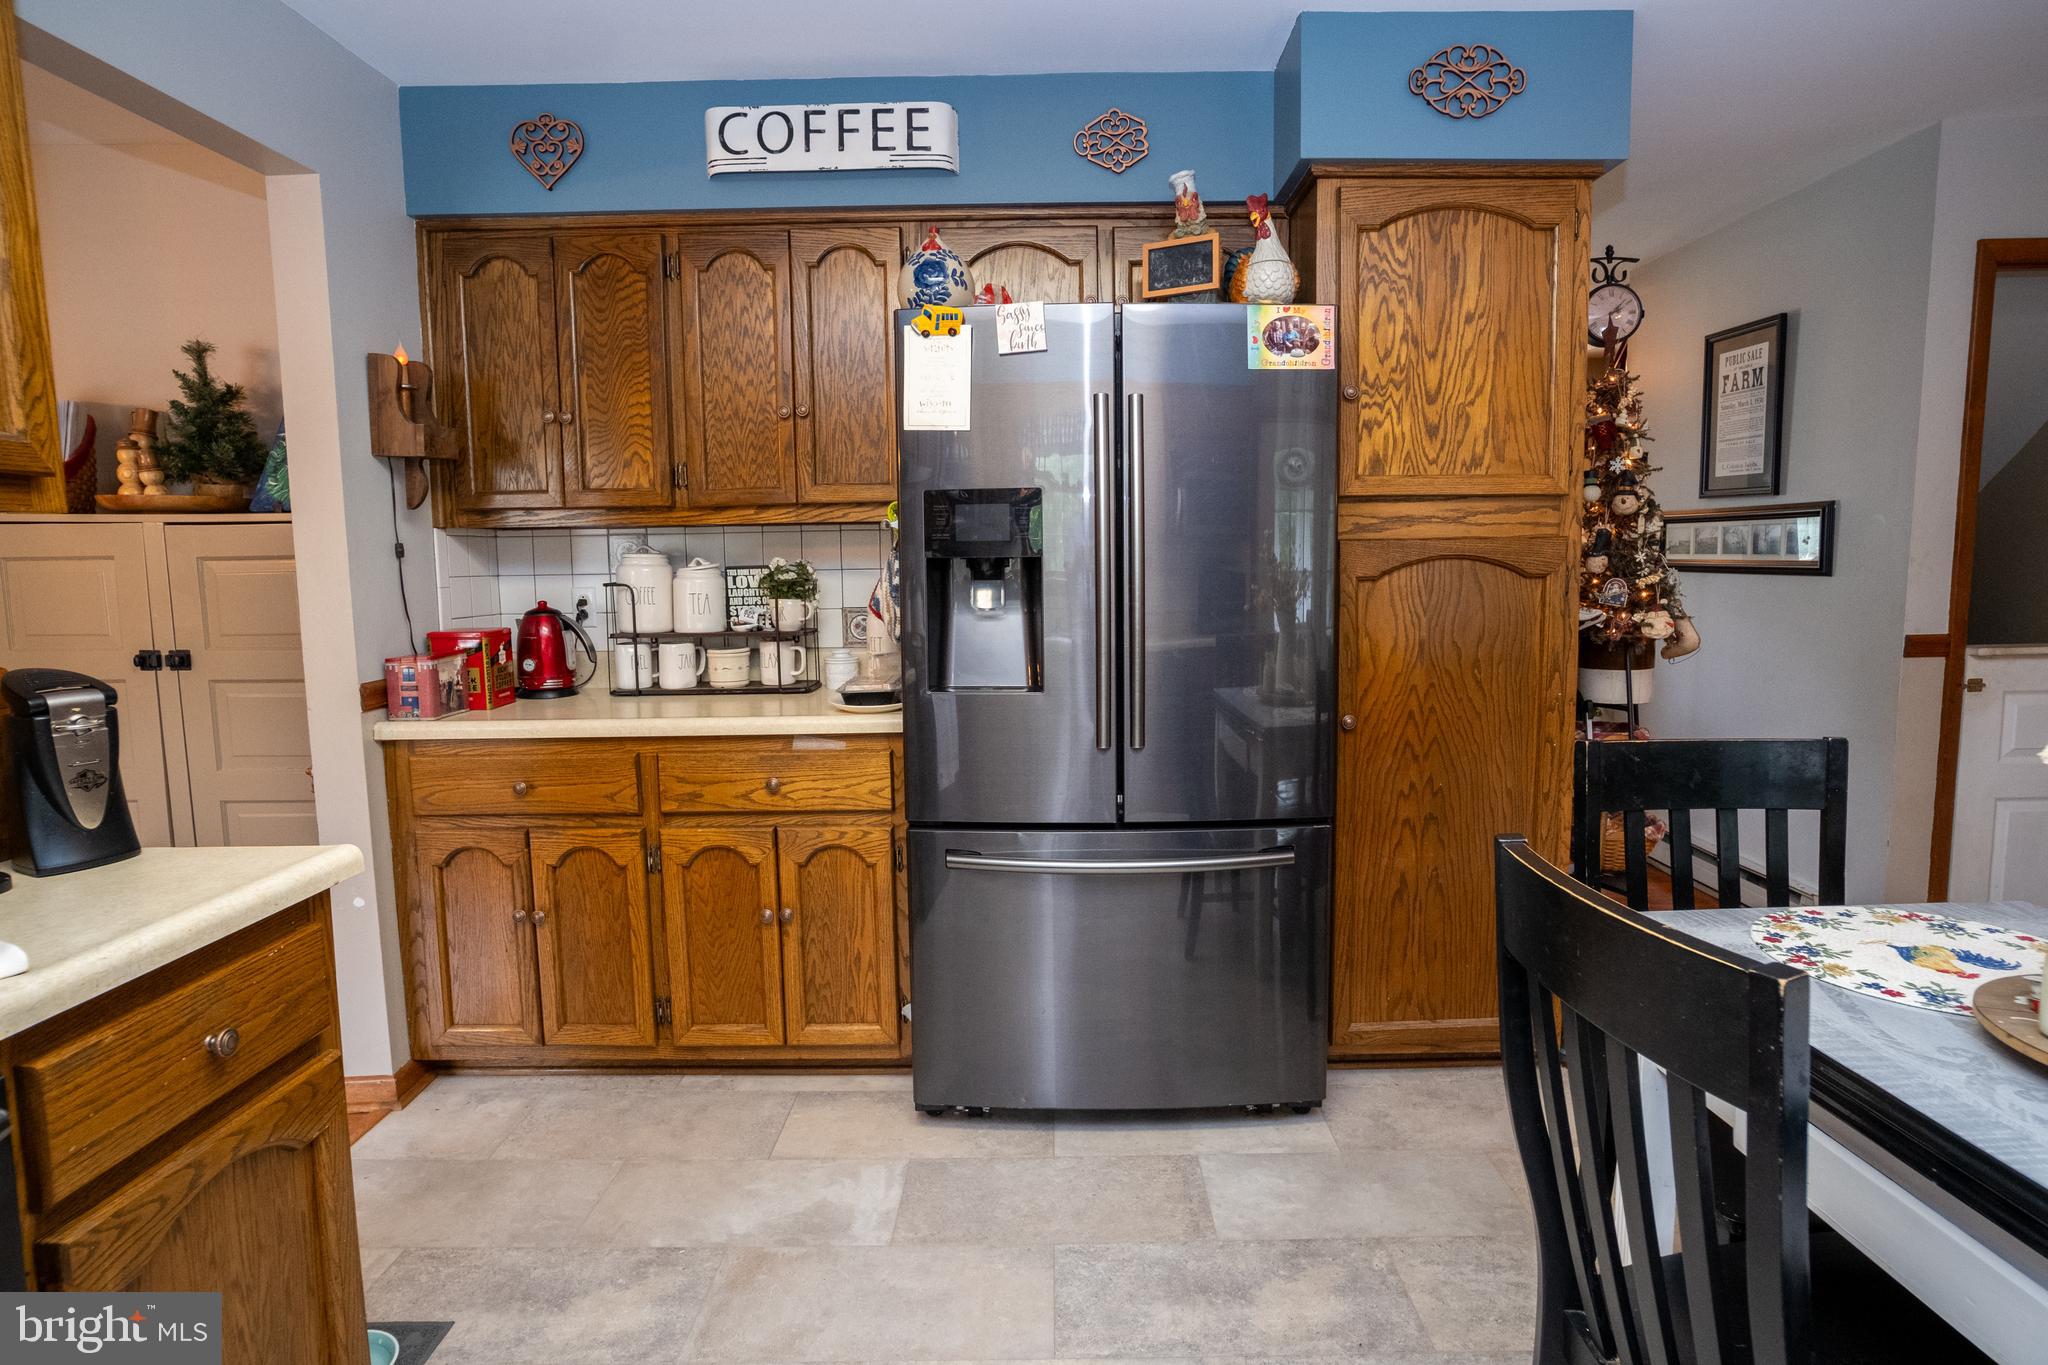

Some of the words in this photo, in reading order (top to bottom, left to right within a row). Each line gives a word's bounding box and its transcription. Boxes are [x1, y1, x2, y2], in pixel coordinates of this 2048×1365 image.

[718, 107, 932, 156] COFFEE
[1725, 352, 1746, 368] PUBLIC
[1747, 348, 1763, 361] SALE
[1722, 366, 1765, 393] FARM
[727, 575, 762, 588] LOV
[688, 592, 711, 615] TEA
[730, 597, 743, 606] AND
[743, 596, 762, 605] CUPS
[678, 652, 696, 670] JAV
